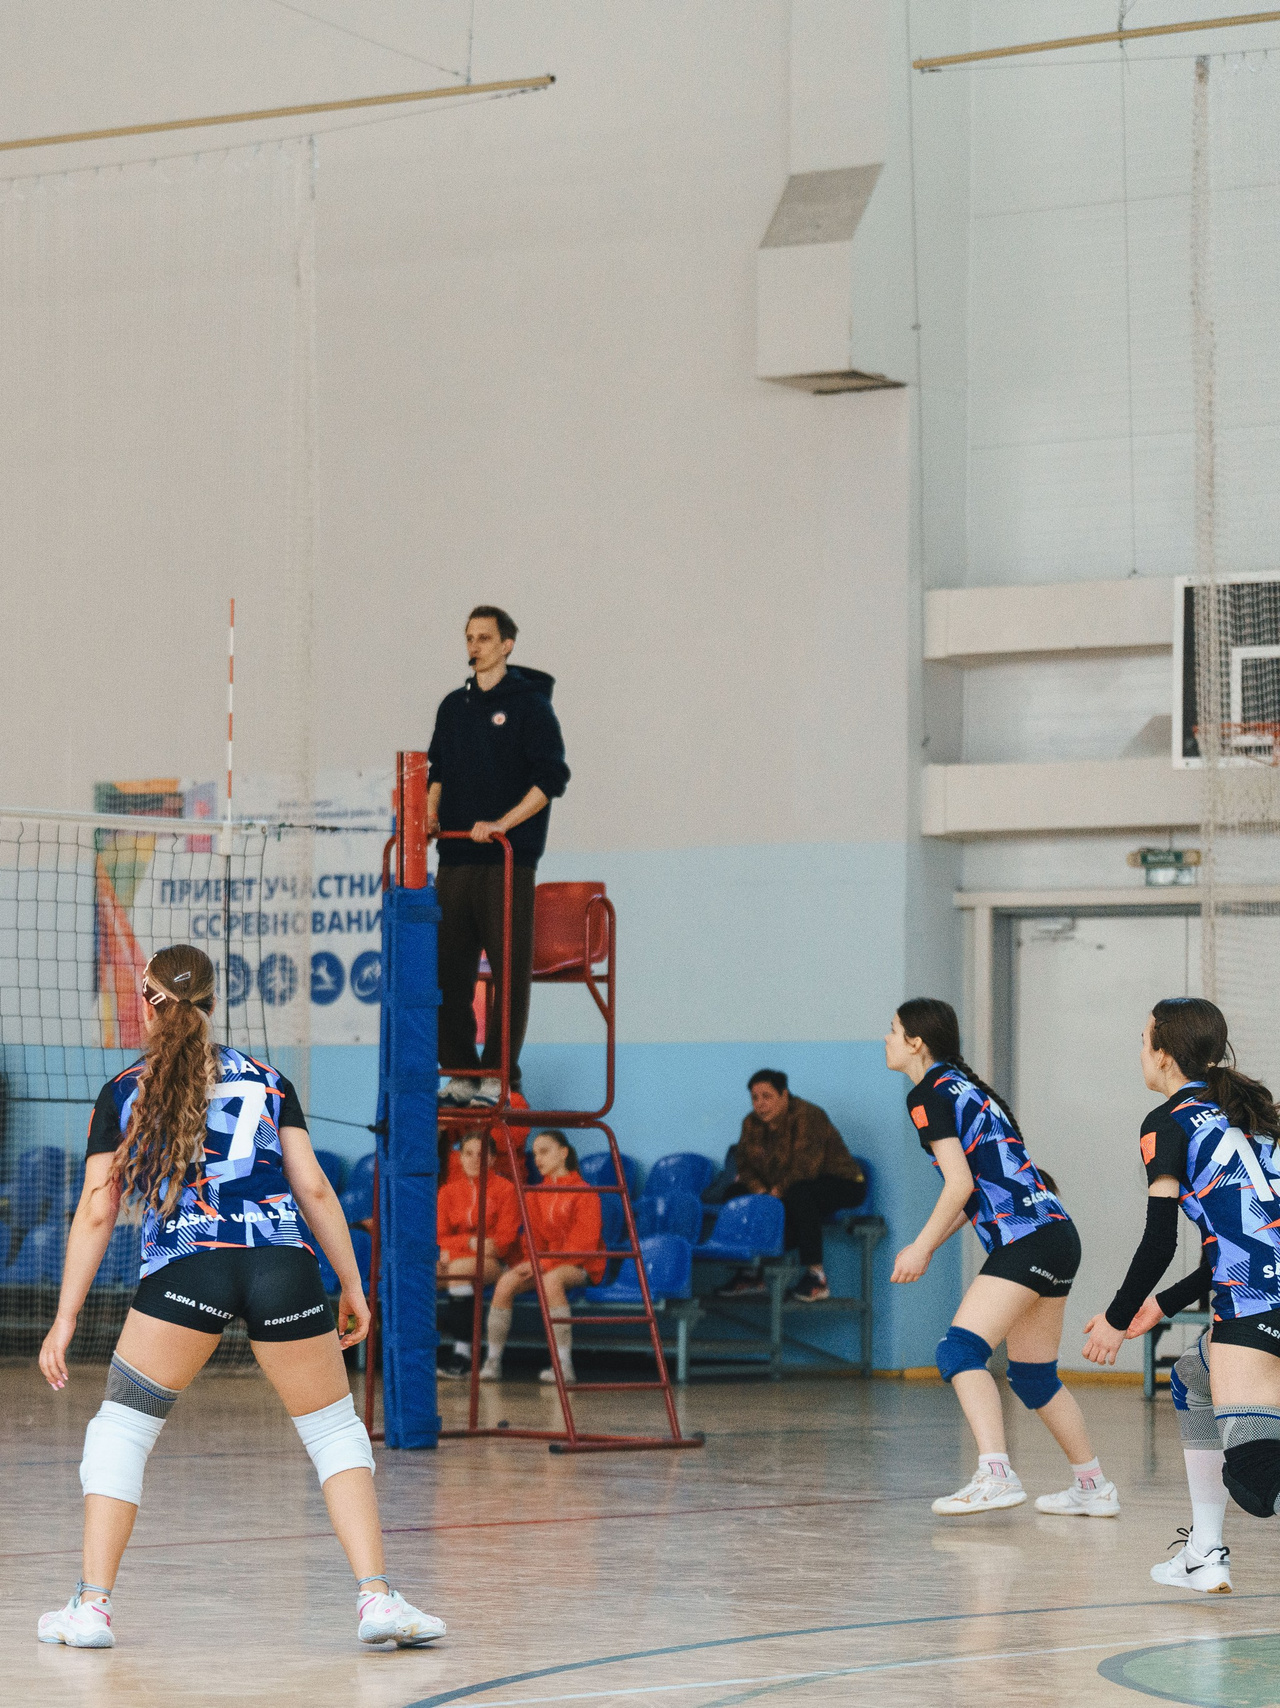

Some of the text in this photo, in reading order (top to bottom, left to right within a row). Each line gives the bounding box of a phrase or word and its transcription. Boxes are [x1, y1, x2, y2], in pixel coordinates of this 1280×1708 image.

[192, 909, 384, 938] СОРЕВНОВАНИ
[190, 1080, 267, 1163] 7
[165, 1208, 297, 1234] SASHA VOLLEY
[1029, 1265, 1054, 1281] SASHA
[164, 1291, 235, 1321] SASHA VOLLEY
[264, 1303, 325, 1327] ROKUS-SPORT
